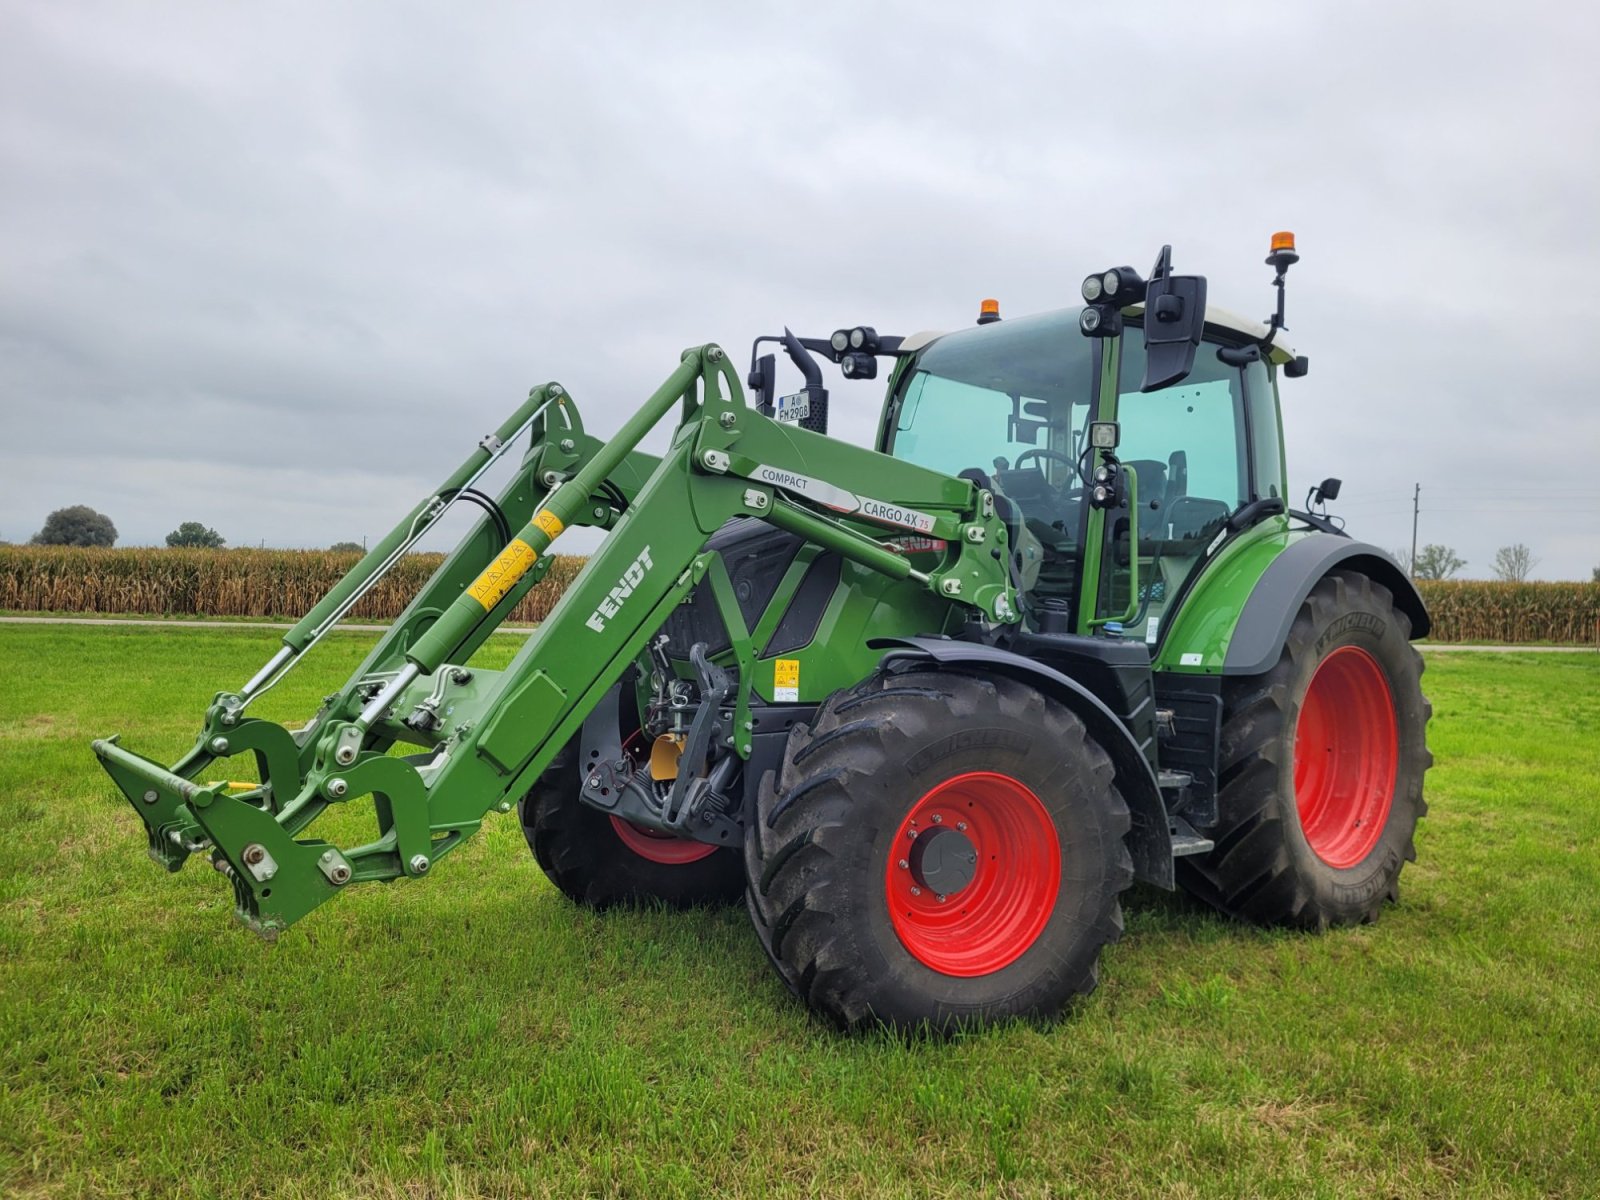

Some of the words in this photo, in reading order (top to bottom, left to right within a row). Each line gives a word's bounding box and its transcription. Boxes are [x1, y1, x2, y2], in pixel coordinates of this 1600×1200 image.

[790, 405, 807, 418] 2908
[762, 469, 808, 489] COMPACT
[864, 502, 903, 522] CARGO
[904, 513, 918, 527] 4X
[920, 519, 929, 529] 75
[585, 545, 653, 633] FENDT
